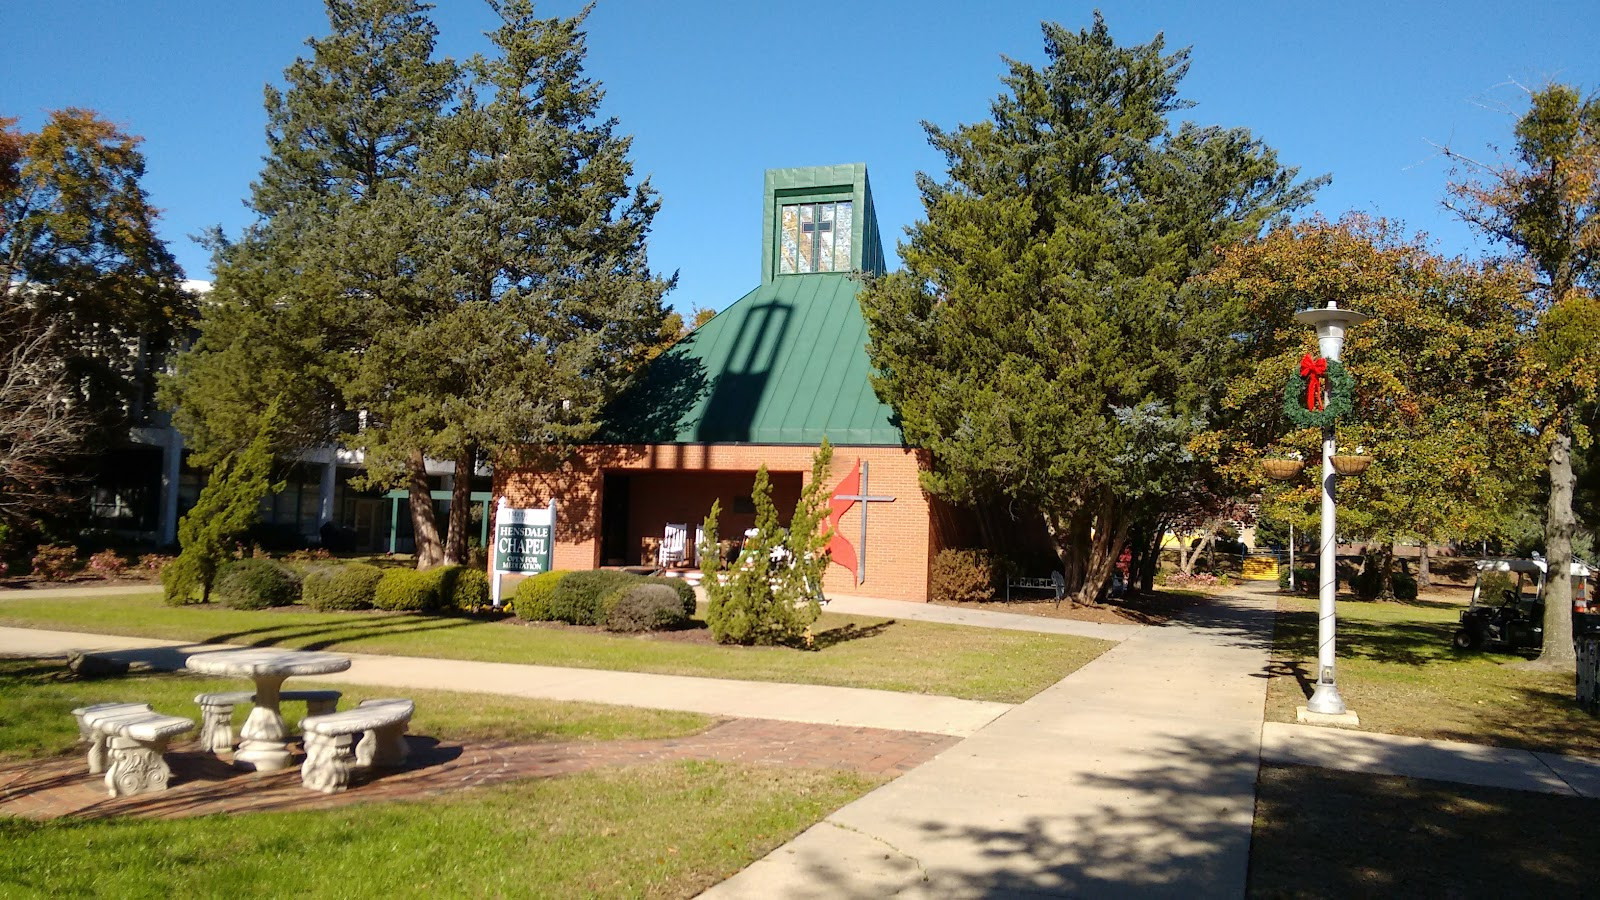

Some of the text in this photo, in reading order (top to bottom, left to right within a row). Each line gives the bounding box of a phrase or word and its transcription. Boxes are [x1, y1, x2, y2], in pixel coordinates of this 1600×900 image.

[500, 526, 549, 537] HENSDALE
[499, 537, 547, 554] CHAPEL
[507, 555, 538, 564] OPEN FOR
[502, 561, 542, 570] MEDITATION
